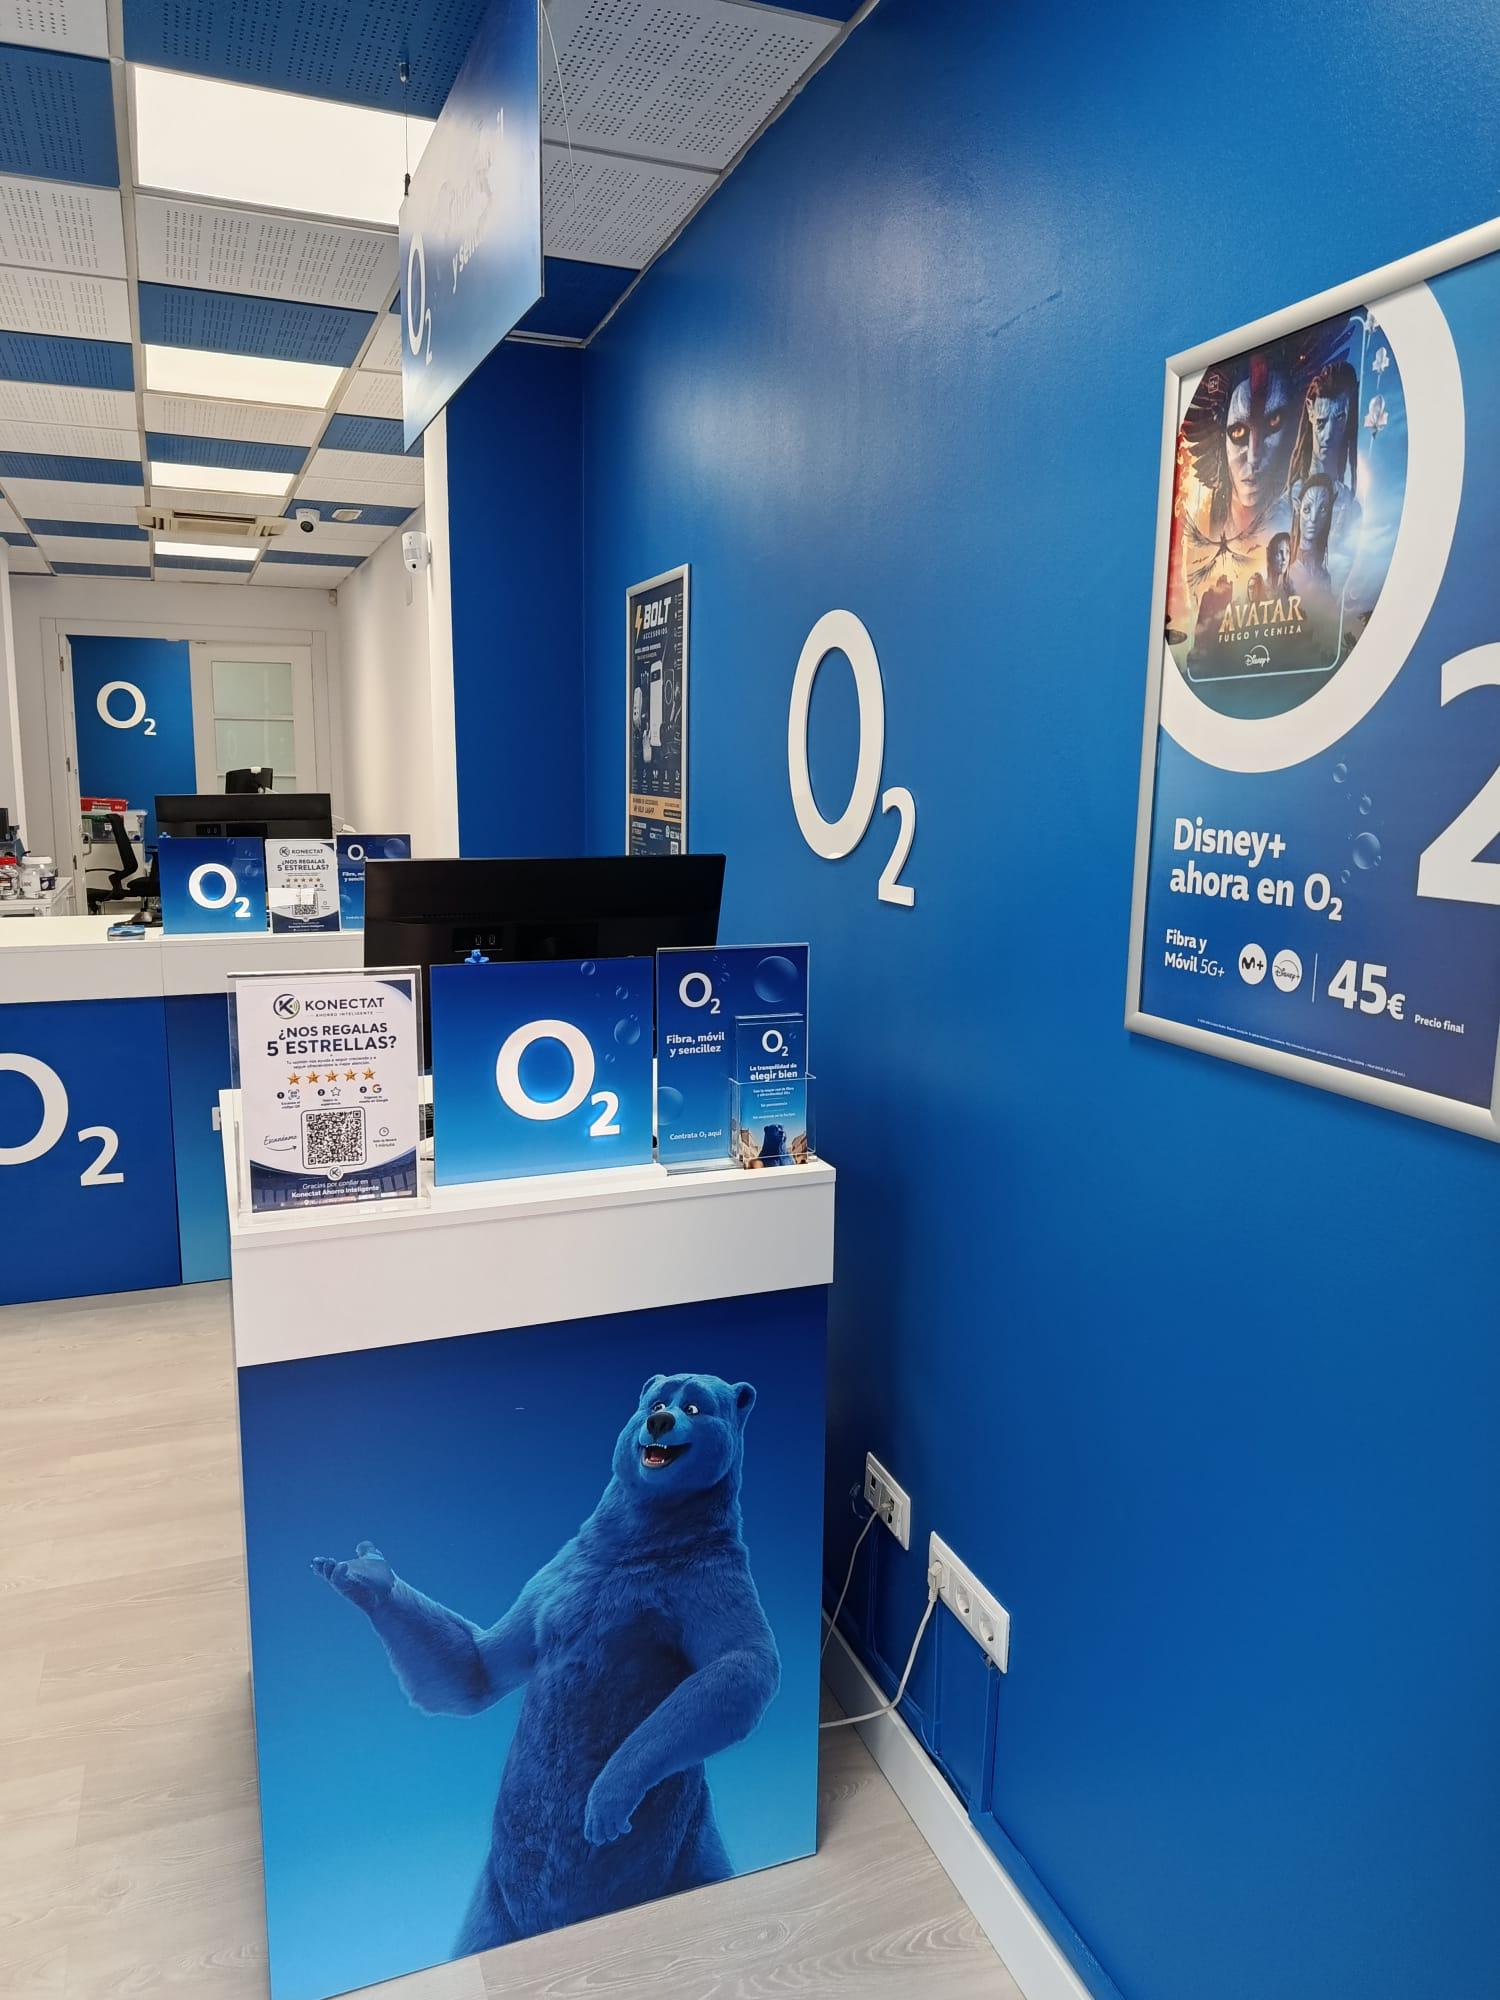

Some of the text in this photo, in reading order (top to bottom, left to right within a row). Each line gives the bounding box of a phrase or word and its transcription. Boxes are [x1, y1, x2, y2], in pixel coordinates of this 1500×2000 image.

[408, 231, 433, 366] O2
[643, 597, 672, 630] BOLT
[1219, 595, 1304, 633] AVATAR
[643, 627, 668, 640] ACCESORIOS
[1218, 625, 1302, 643] FUEGO Y CENIZA
[97, 681, 157, 736] O2
[788, 608, 916, 907] O2
[1173, 817, 1286, 868] Disney+
[188, 862, 251, 918] O2
[1170, 861, 1343, 921] ahora en O2
[1166, 929, 1207, 954] Fibra y
[1164, 952, 1198, 973] Móvil
[1199, 955, 1225, 977] 5G+
[679, 972, 721, 1014] O2
[1328, 960, 1406, 1020] 45€
[305, 997, 384, 1011] KONECTAT
[279, 1022, 388, 1040] ¿NOS REGALAS
[1414, 1014, 1465, 1034] Precio final
[267, 1036, 397, 1056] 5 ESTRELLAS?
[666, 1031, 725, 1044] Fibra, móvil
[761, 1030, 789, 1057] O2
[669, 1043, 722, 1058] y sencillez
[496, 1019, 621, 1136] O2
[750, 1069, 798, 1082] elegir bien
[669, 1131, 698, 1140] Contrata
[708, 1129, 722, 1138] aquí
[291, 1185, 380, 1198] Konectat Ahorro Inteligente
[302, 1181, 326, 1190] Gracias
[326, 1181, 337, 1189] por
